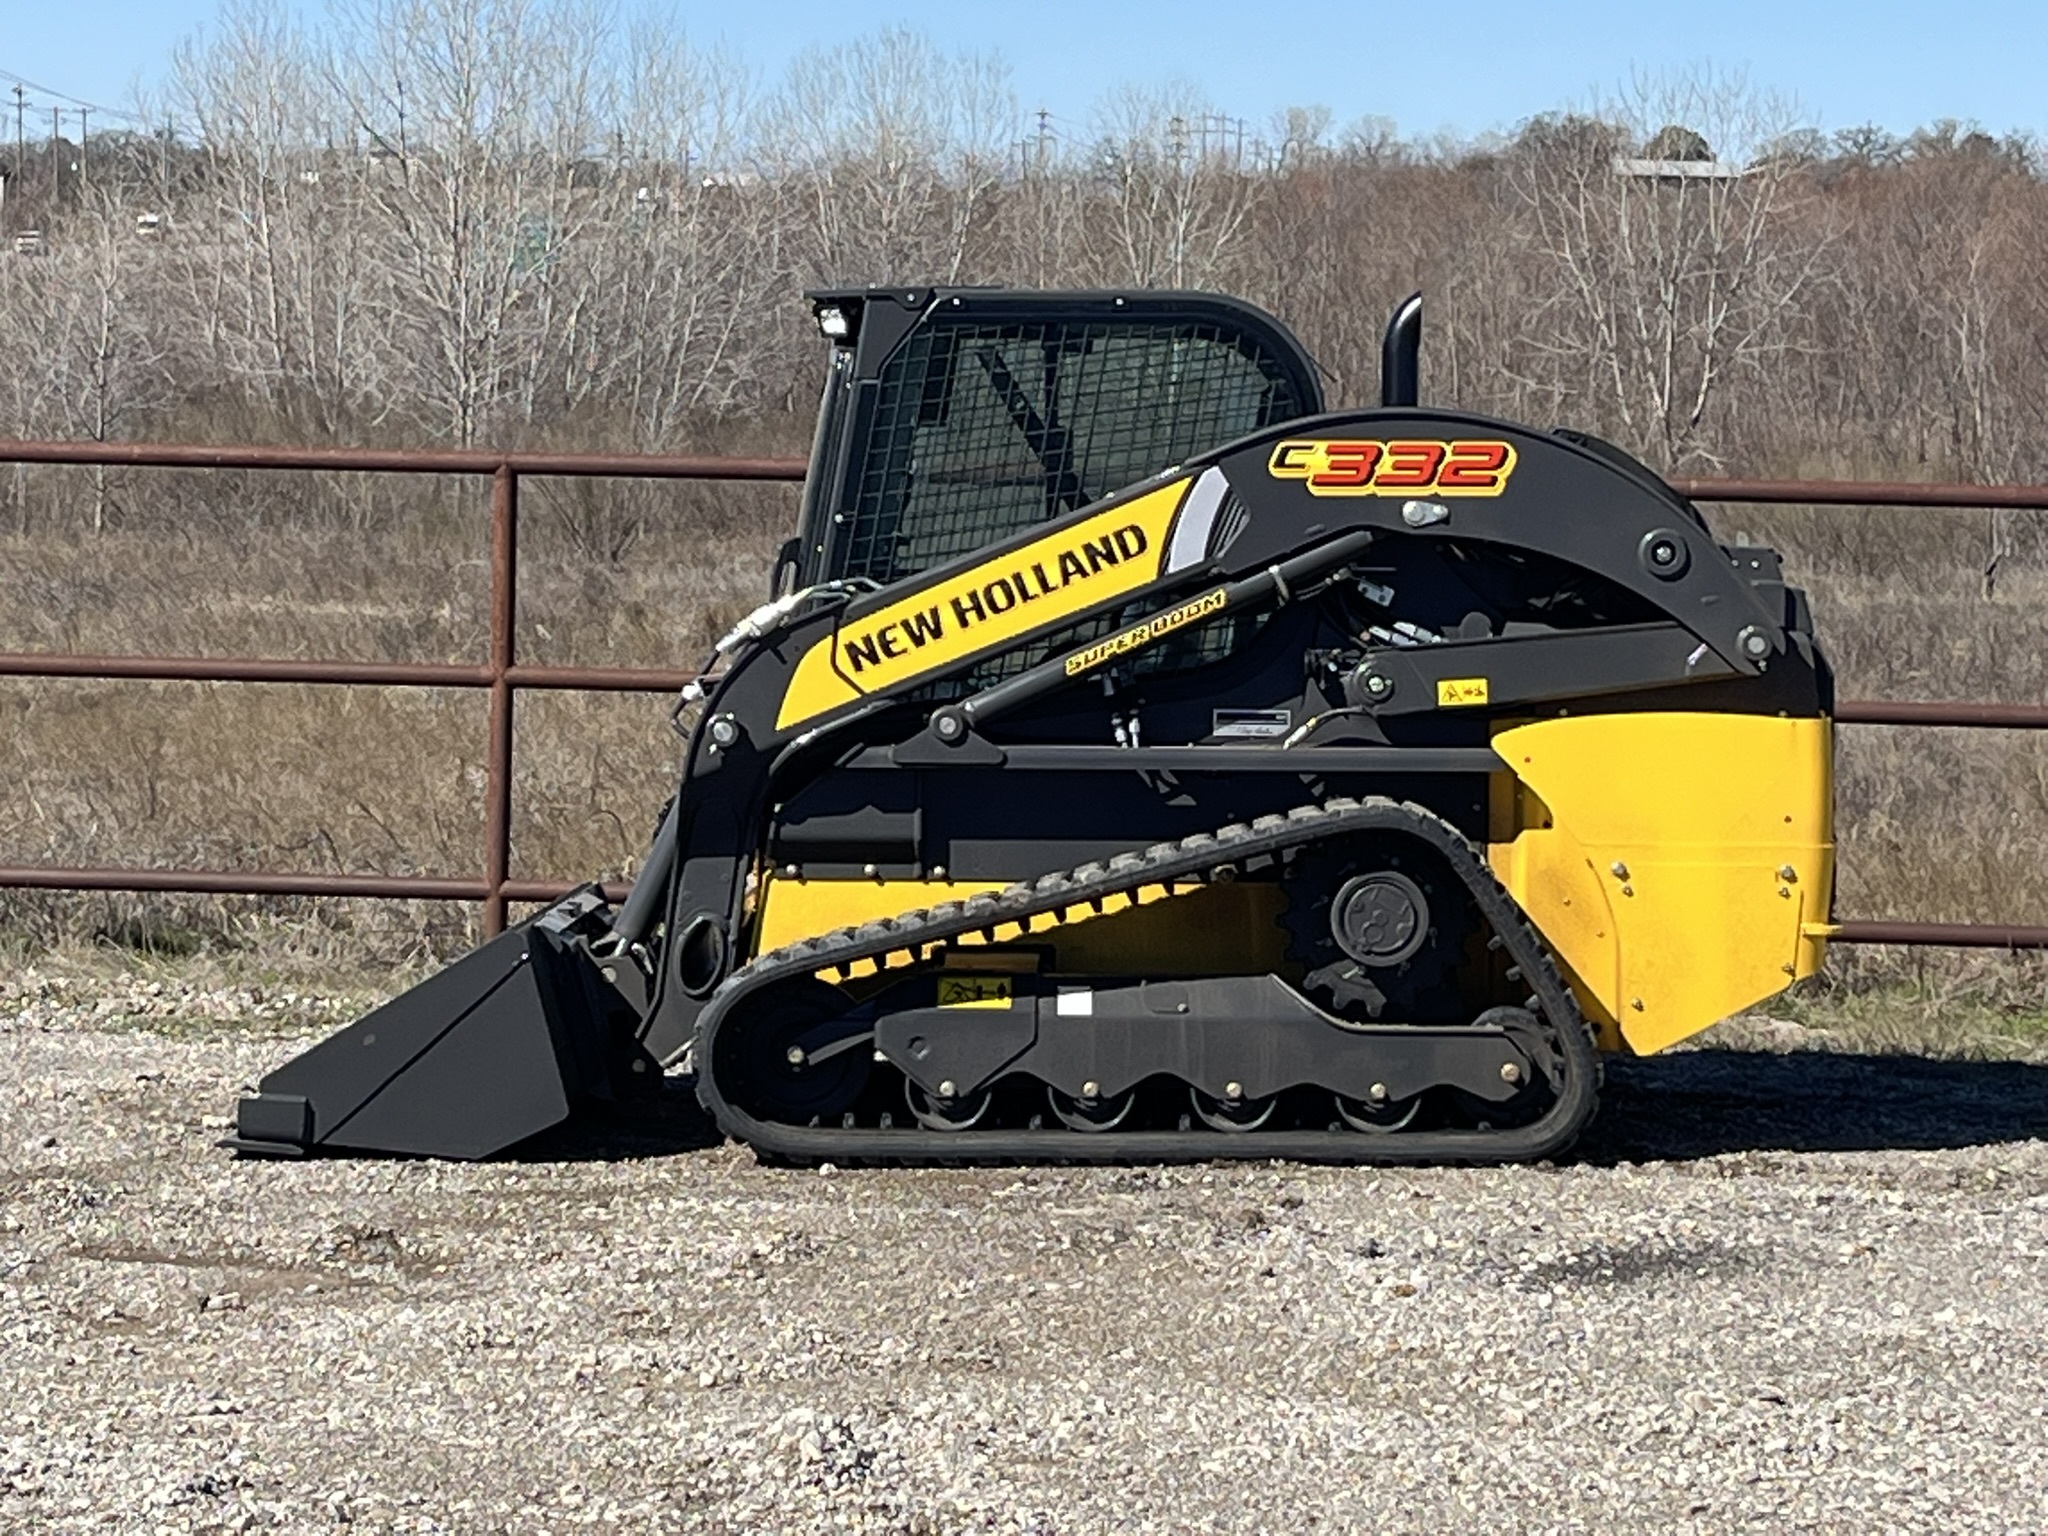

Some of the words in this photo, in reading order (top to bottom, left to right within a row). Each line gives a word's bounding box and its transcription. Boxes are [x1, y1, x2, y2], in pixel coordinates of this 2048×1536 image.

[1271, 443, 1513, 491] C332
[843, 604, 944, 673] NEW
[949, 523, 1148, 629] HOLLAND
[1067, 627, 1148, 674] SUPER
[1152, 590, 1225, 635] BOOM
